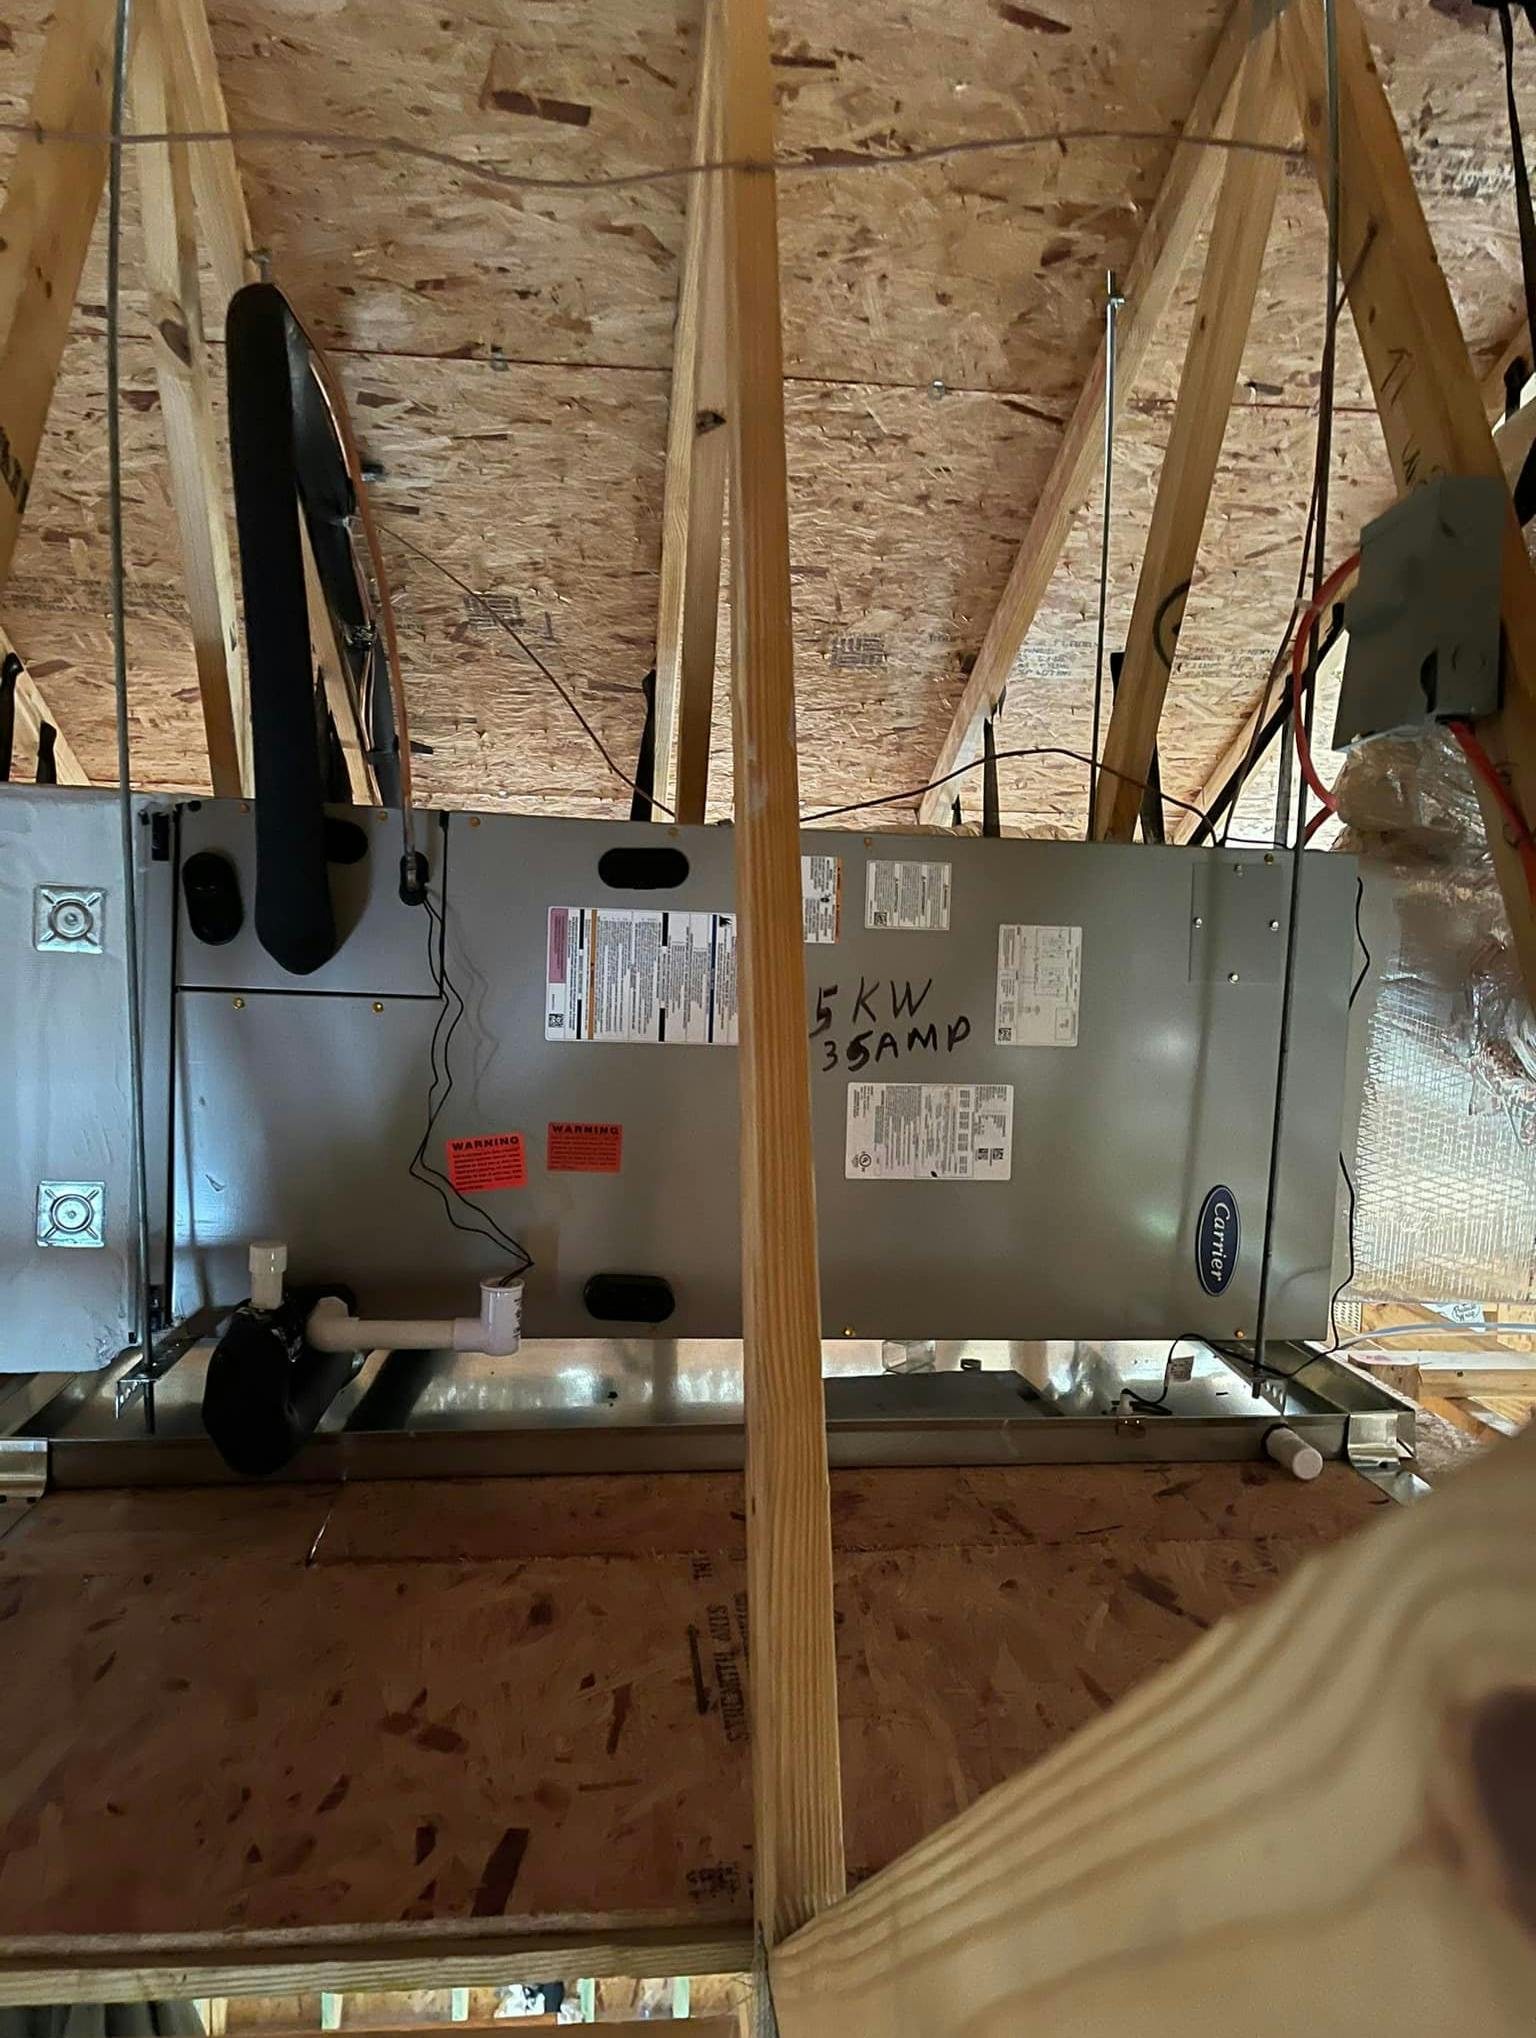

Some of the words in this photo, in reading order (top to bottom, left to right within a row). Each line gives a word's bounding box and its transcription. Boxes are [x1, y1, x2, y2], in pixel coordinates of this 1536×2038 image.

[809, 984, 838, 1039] 5
[852, 976, 932, 1024] KW
[452, 1136, 519, 1151] WARNING
[552, 1125, 620, 1135] WARNING
[1210, 1202, 1231, 1282] Carrier
